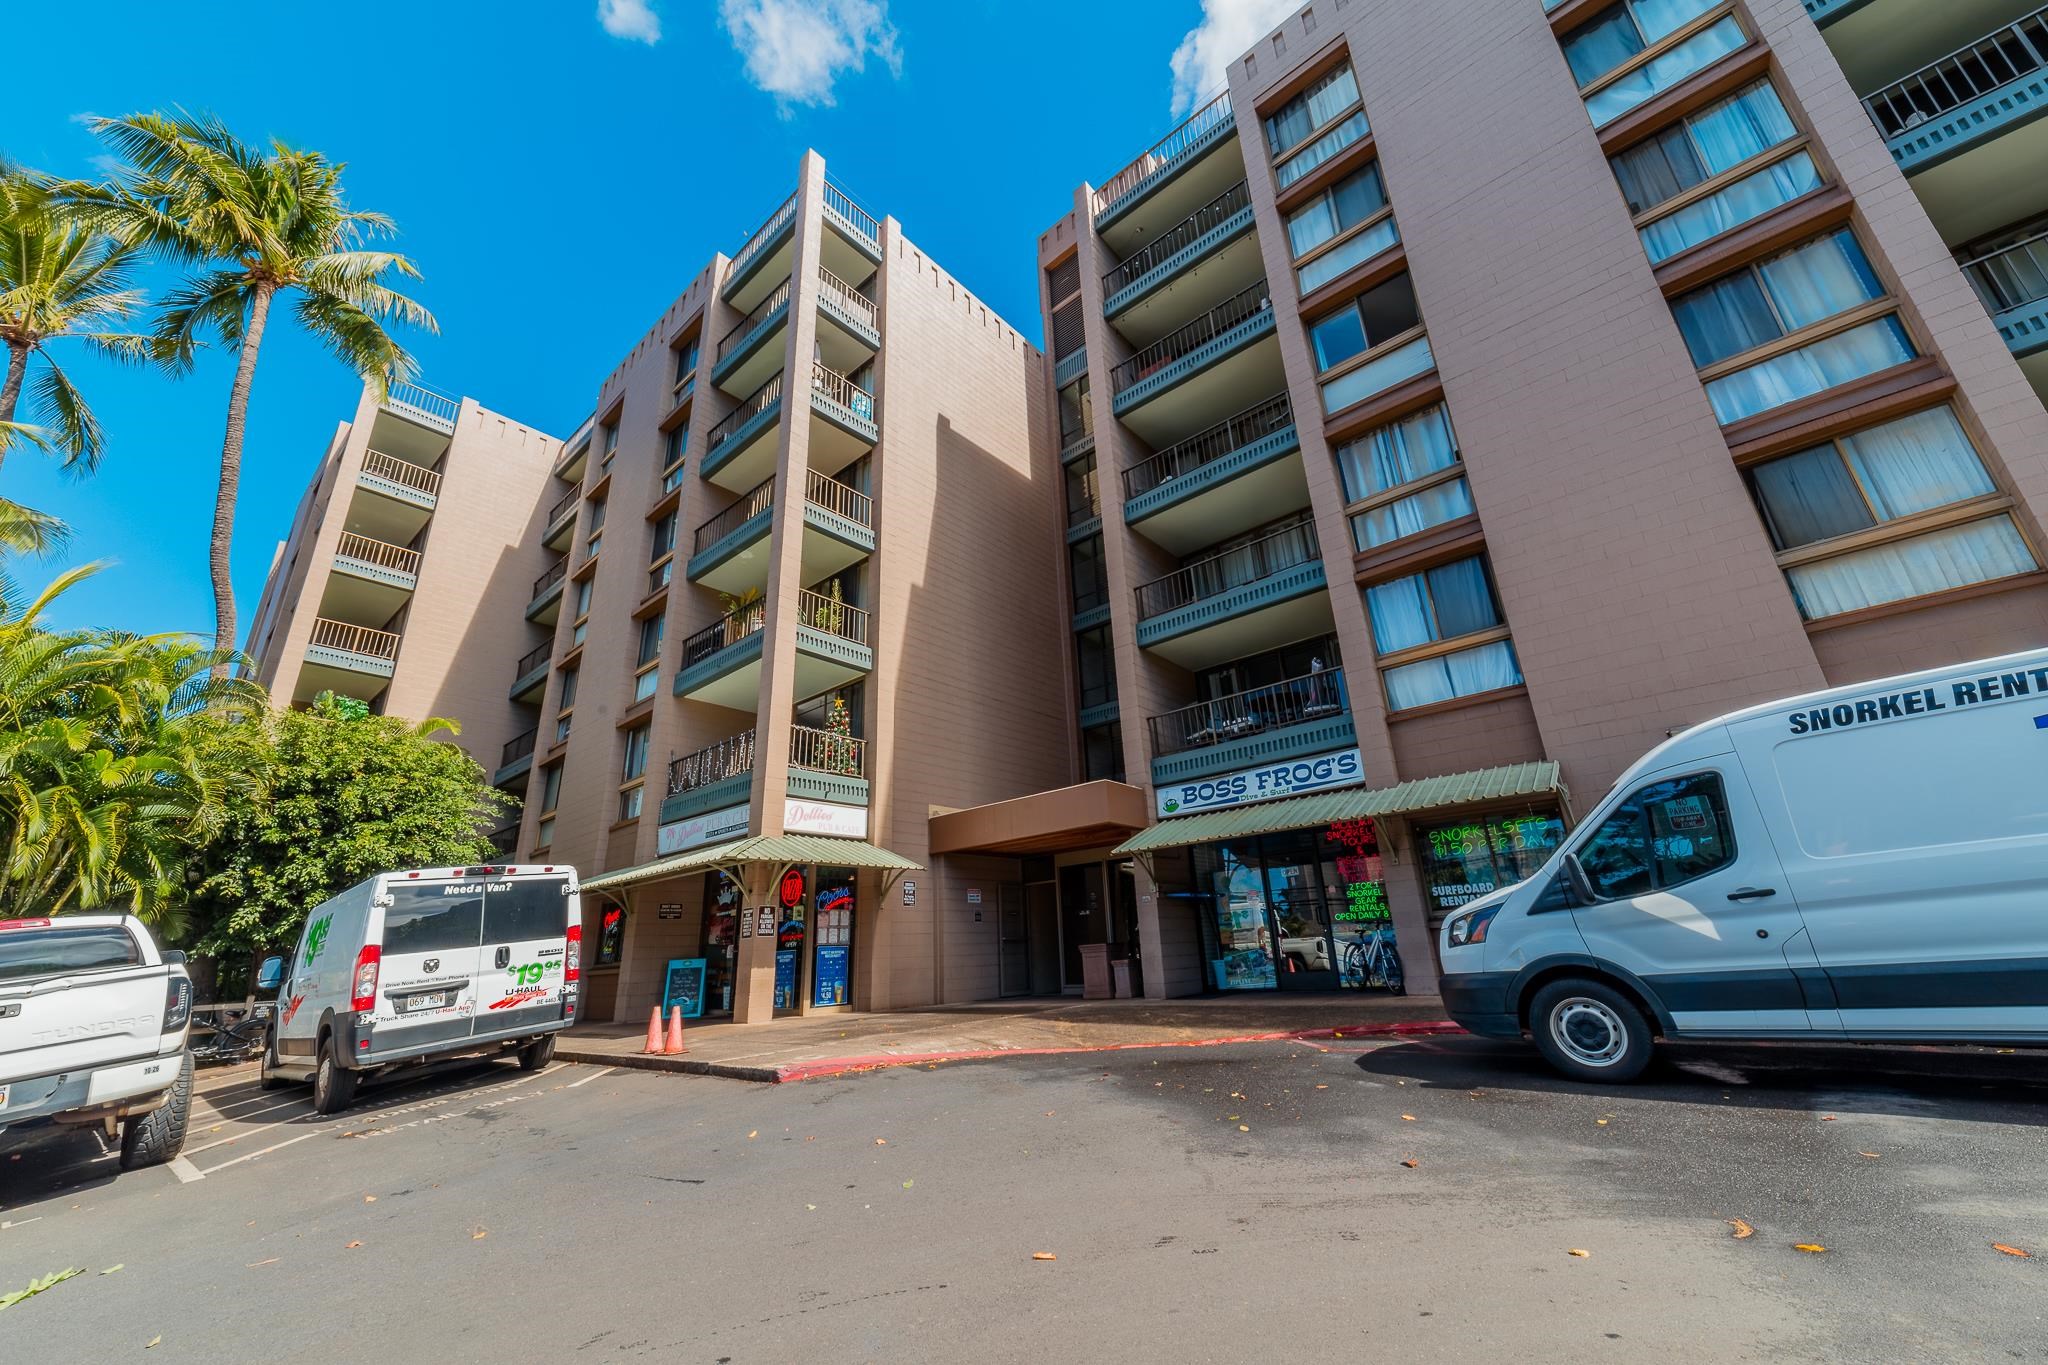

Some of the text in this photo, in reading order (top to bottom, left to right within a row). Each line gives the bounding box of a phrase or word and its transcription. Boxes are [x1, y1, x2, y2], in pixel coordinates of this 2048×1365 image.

[1789, 688, 1946, 735] SNORKEL
[1181, 753, 1358, 805] BOSS FROG'S
[1240, 793, 1259, 802] Dive
[1269, 787, 1290, 797] Surf
[786, 805, 833, 827] Dollies
[1668, 805, 1700, 816] PARKING
[1342, 835, 1376, 846] TOURS
[1514, 835, 1545, 849] DAY
[444, 884, 474, 895] Need
[486, 882, 513, 893] Van?
[1349, 883, 1355, 891] 2
[1355, 881, 1373, 890] FOR
[1431, 882, 1494, 897] SURFBOARD
[1346, 888, 1383, 898] SNORKEL
[1349, 902, 1386, 912] RENTALS
[1355, 897, 1377, 905] GEAR
[1334, 912, 1357, 921] OPEN
[1358, 911, 1380, 920] DAILY
[505, 985, 542, 996] U-HAUL
[32, 1014, 156, 1043] TUNDRA
